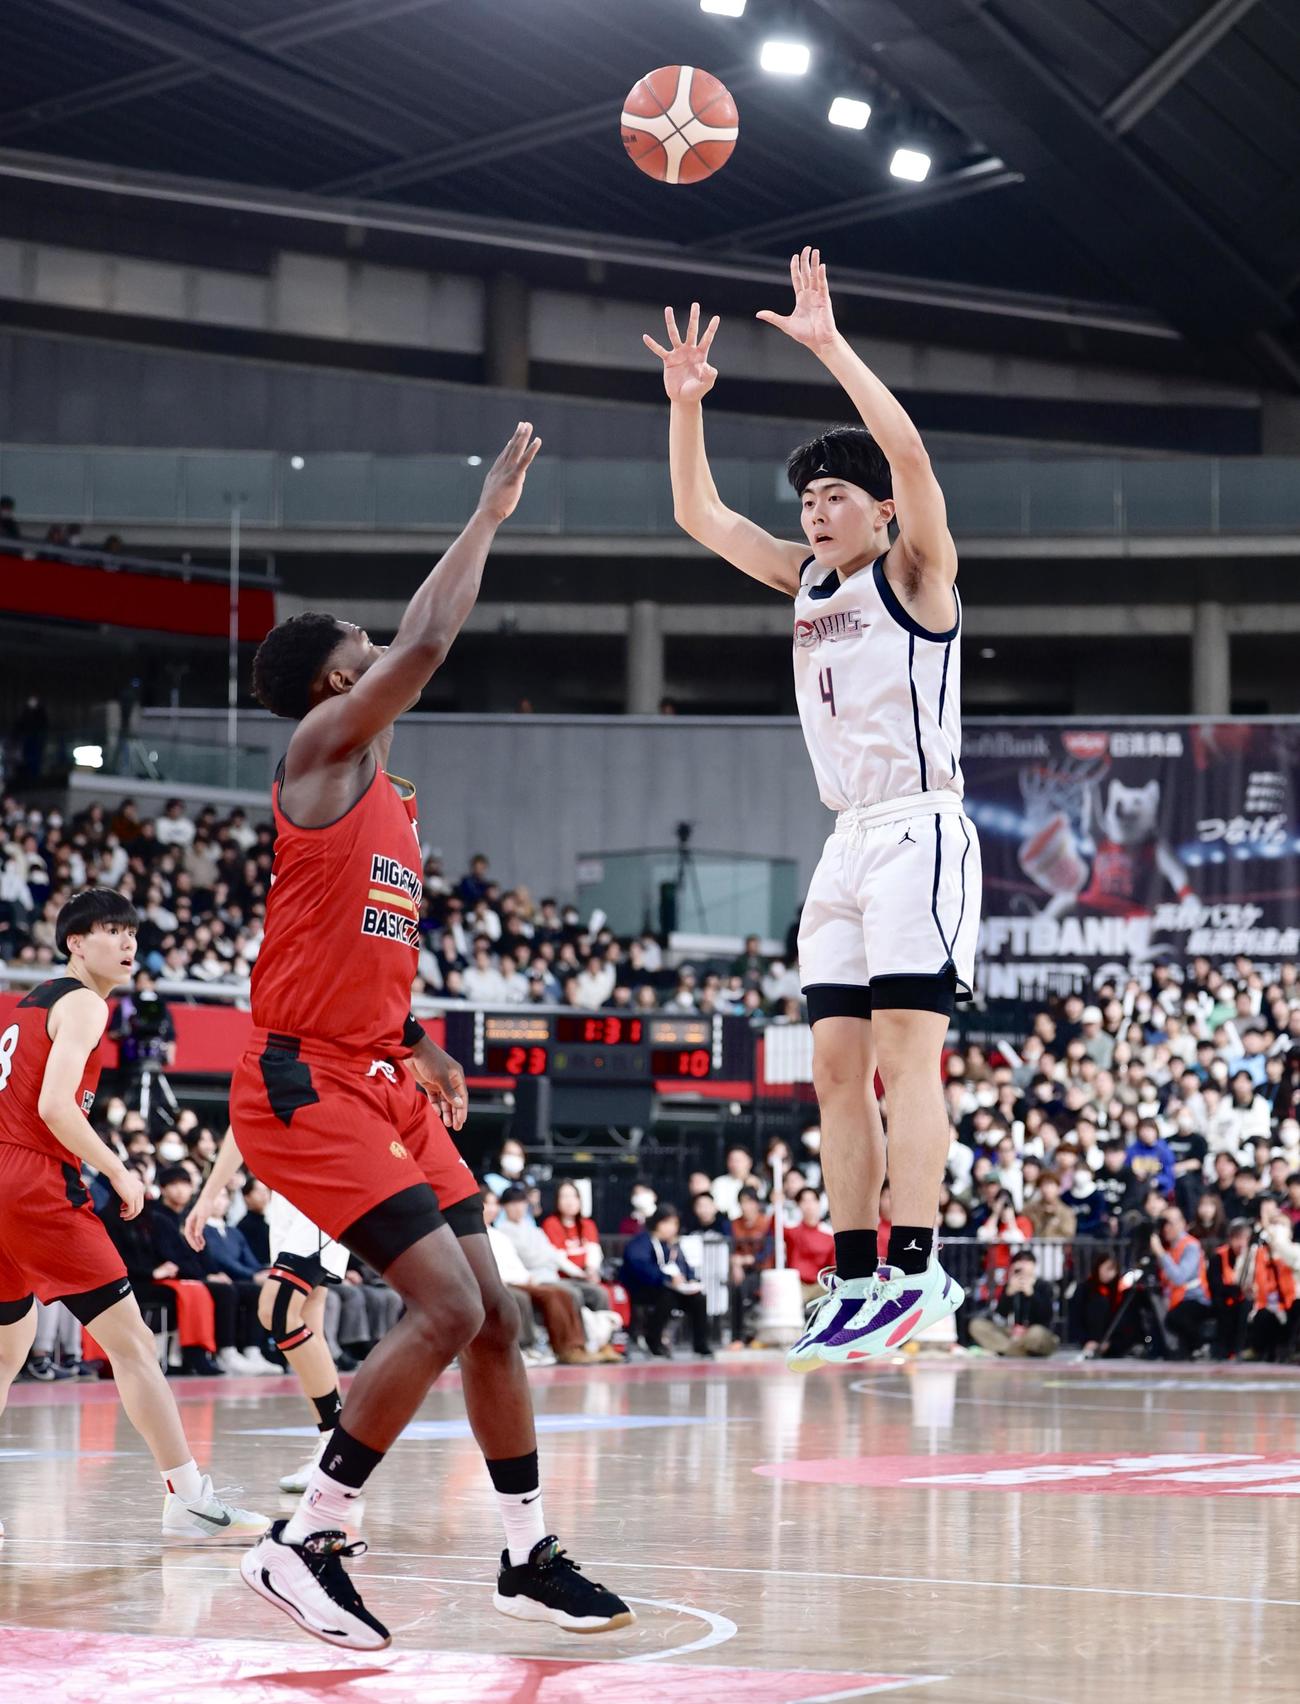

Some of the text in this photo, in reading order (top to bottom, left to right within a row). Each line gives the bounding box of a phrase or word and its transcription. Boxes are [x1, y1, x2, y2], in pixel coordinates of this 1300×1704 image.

[818, 667, 837, 717] 4
[981, 915, 1152, 957] FTBANK
[584, 1016, 642, 1045] 1:31
[506, 1046, 710, 1077] 23 10
